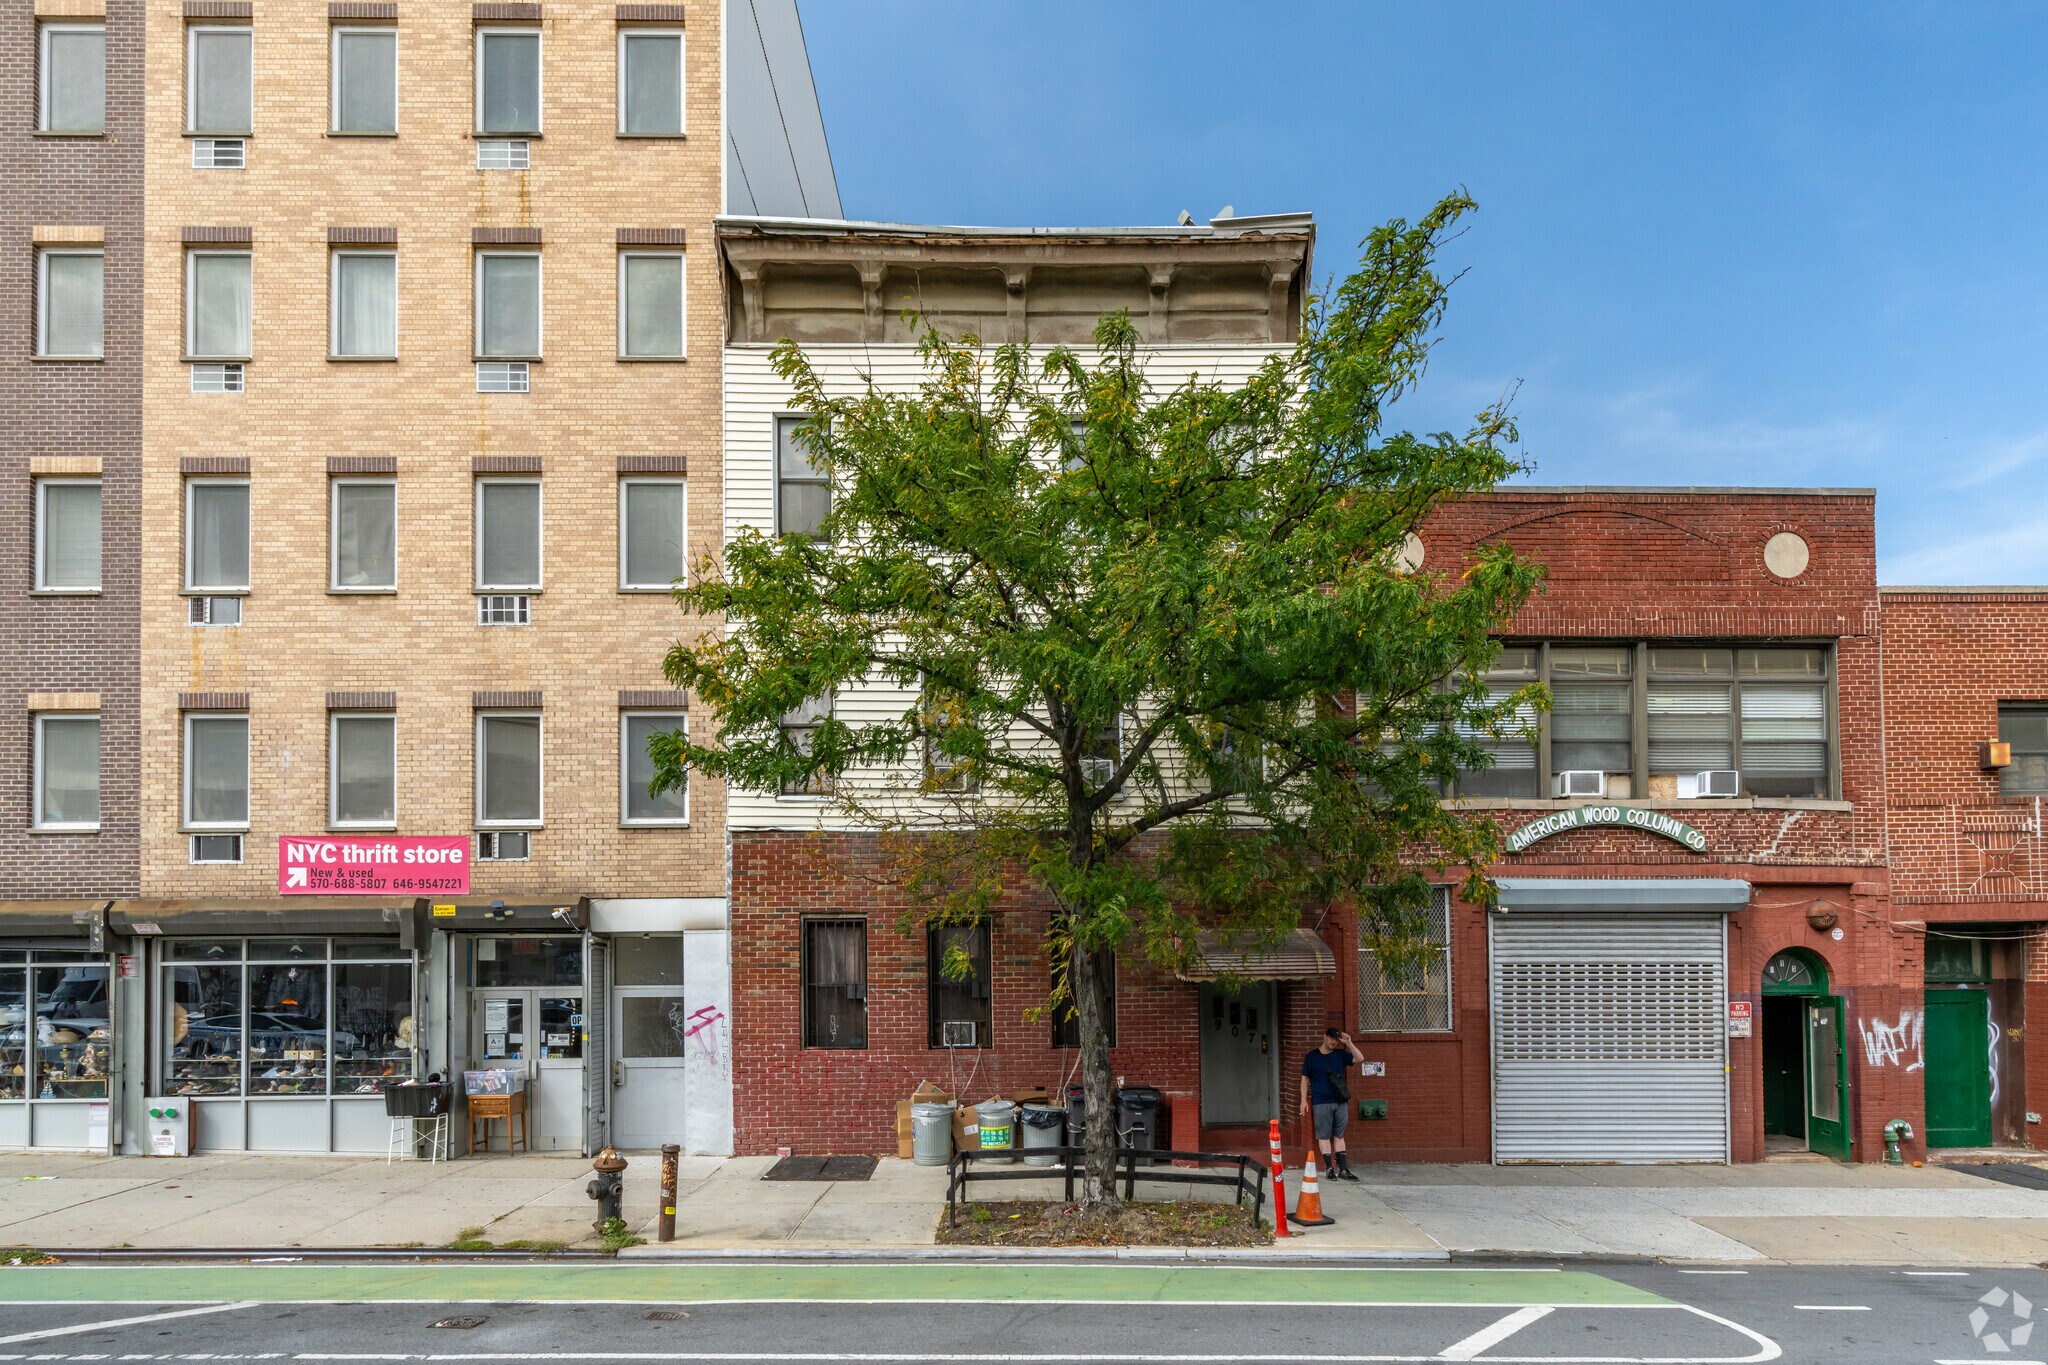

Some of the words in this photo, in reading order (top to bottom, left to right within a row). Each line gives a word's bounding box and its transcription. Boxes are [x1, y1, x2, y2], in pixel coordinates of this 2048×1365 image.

[1511, 811, 1578, 851] AMERICAN
[1582, 807, 1620, 824] WOOD
[1626, 809, 1683, 838] COLUMN
[1685, 830, 1706, 850] CO
[287, 843, 337, 863] NYC
[342, 844, 399, 864] thrift
[403, 845, 463, 864] store
[310, 867, 333, 878] New
[336, 867, 345, 878] &
[348, 867, 374, 878] used
[310, 878, 387, 889] 570-688-5807
[393, 878, 462, 889] 646-9547221
[572, 1016, 582, 1025] OP
